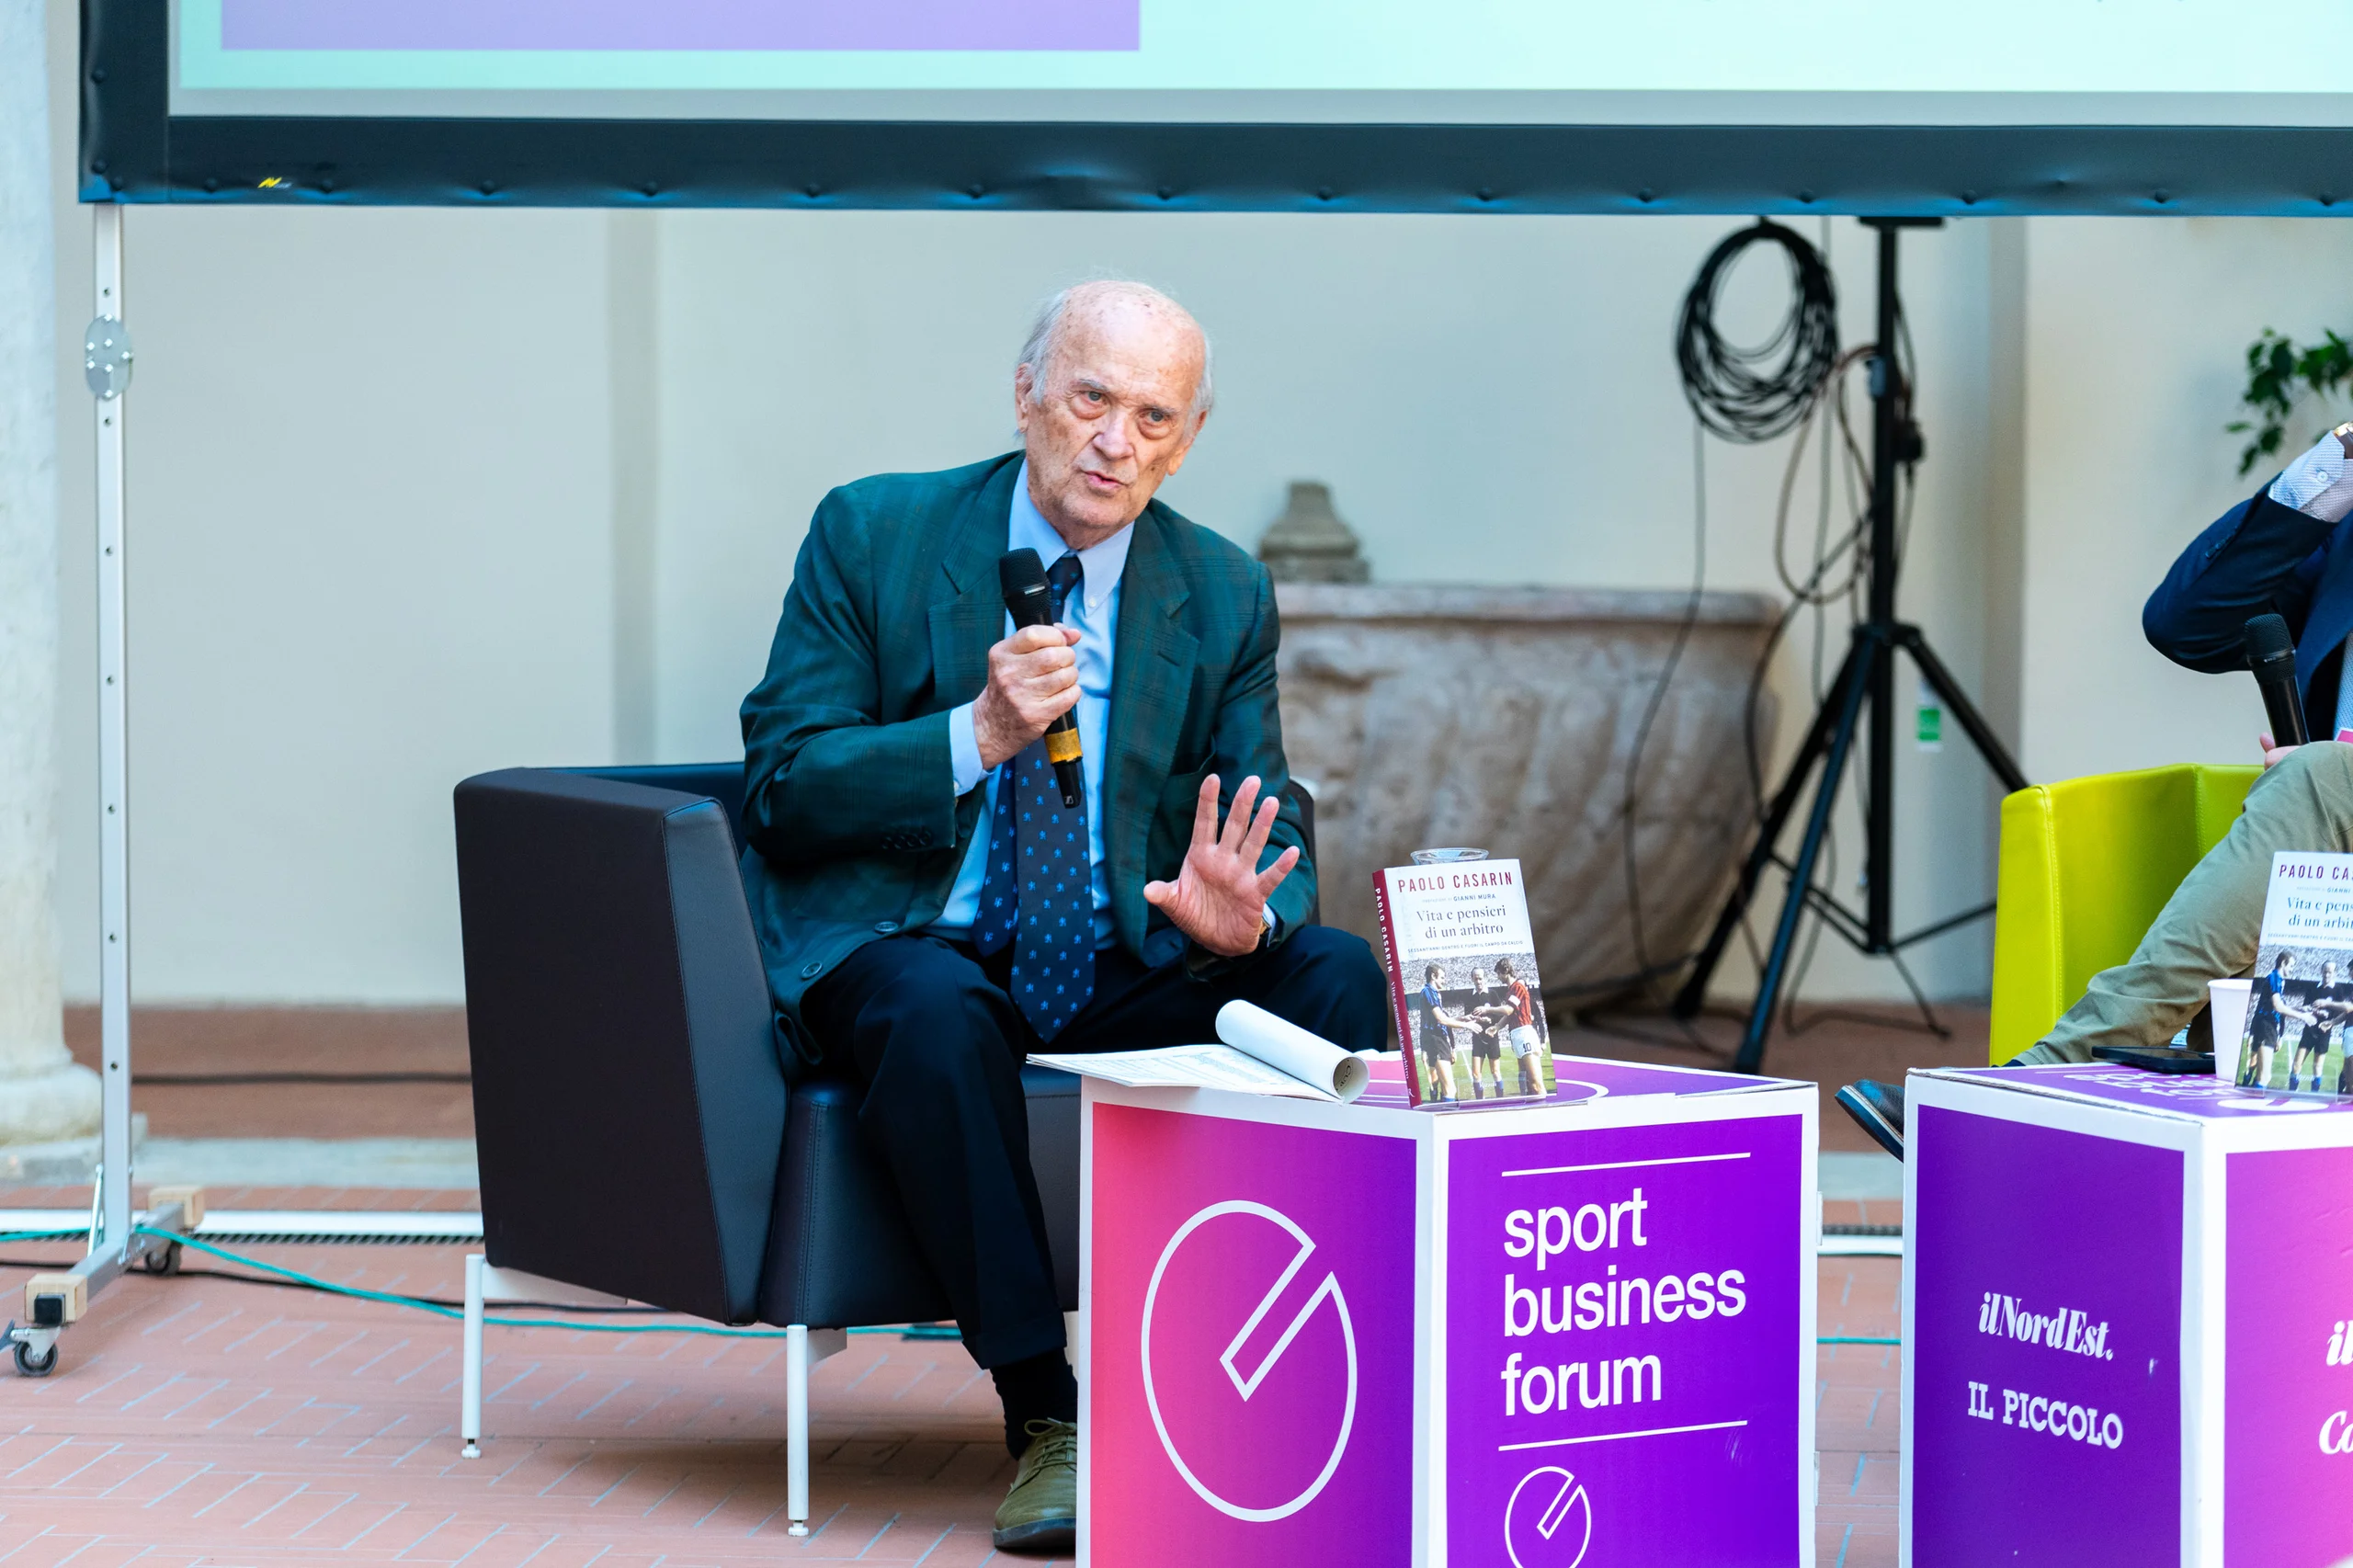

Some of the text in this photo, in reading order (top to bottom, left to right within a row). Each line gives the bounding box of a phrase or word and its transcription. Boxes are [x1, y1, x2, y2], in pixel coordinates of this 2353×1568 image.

[1398, 871, 1513, 892] PAOLO CASARIN
[2279, 864, 2353, 881] PAOLO CA
[1416, 904, 1506, 923] Vita e pensieri
[2288, 897, 2312, 910] Vita
[2315, 902, 2323, 911] e
[1375, 887, 1393, 972] PAOLO CASARIN
[2289, 914, 2301, 926] di
[2304, 917, 2320, 927] un
[1425, 923, 1504, 939] di un arbitro
[1522, 1042, 1532, 1052] 10
[1504, 1187, 1648, 1271] sport
[1504, 1265, 1746, 1337] business
[1501, 1352, 1662, 1415] forum
[1968, 1381, 2123, 1449] IL PICCOLO
